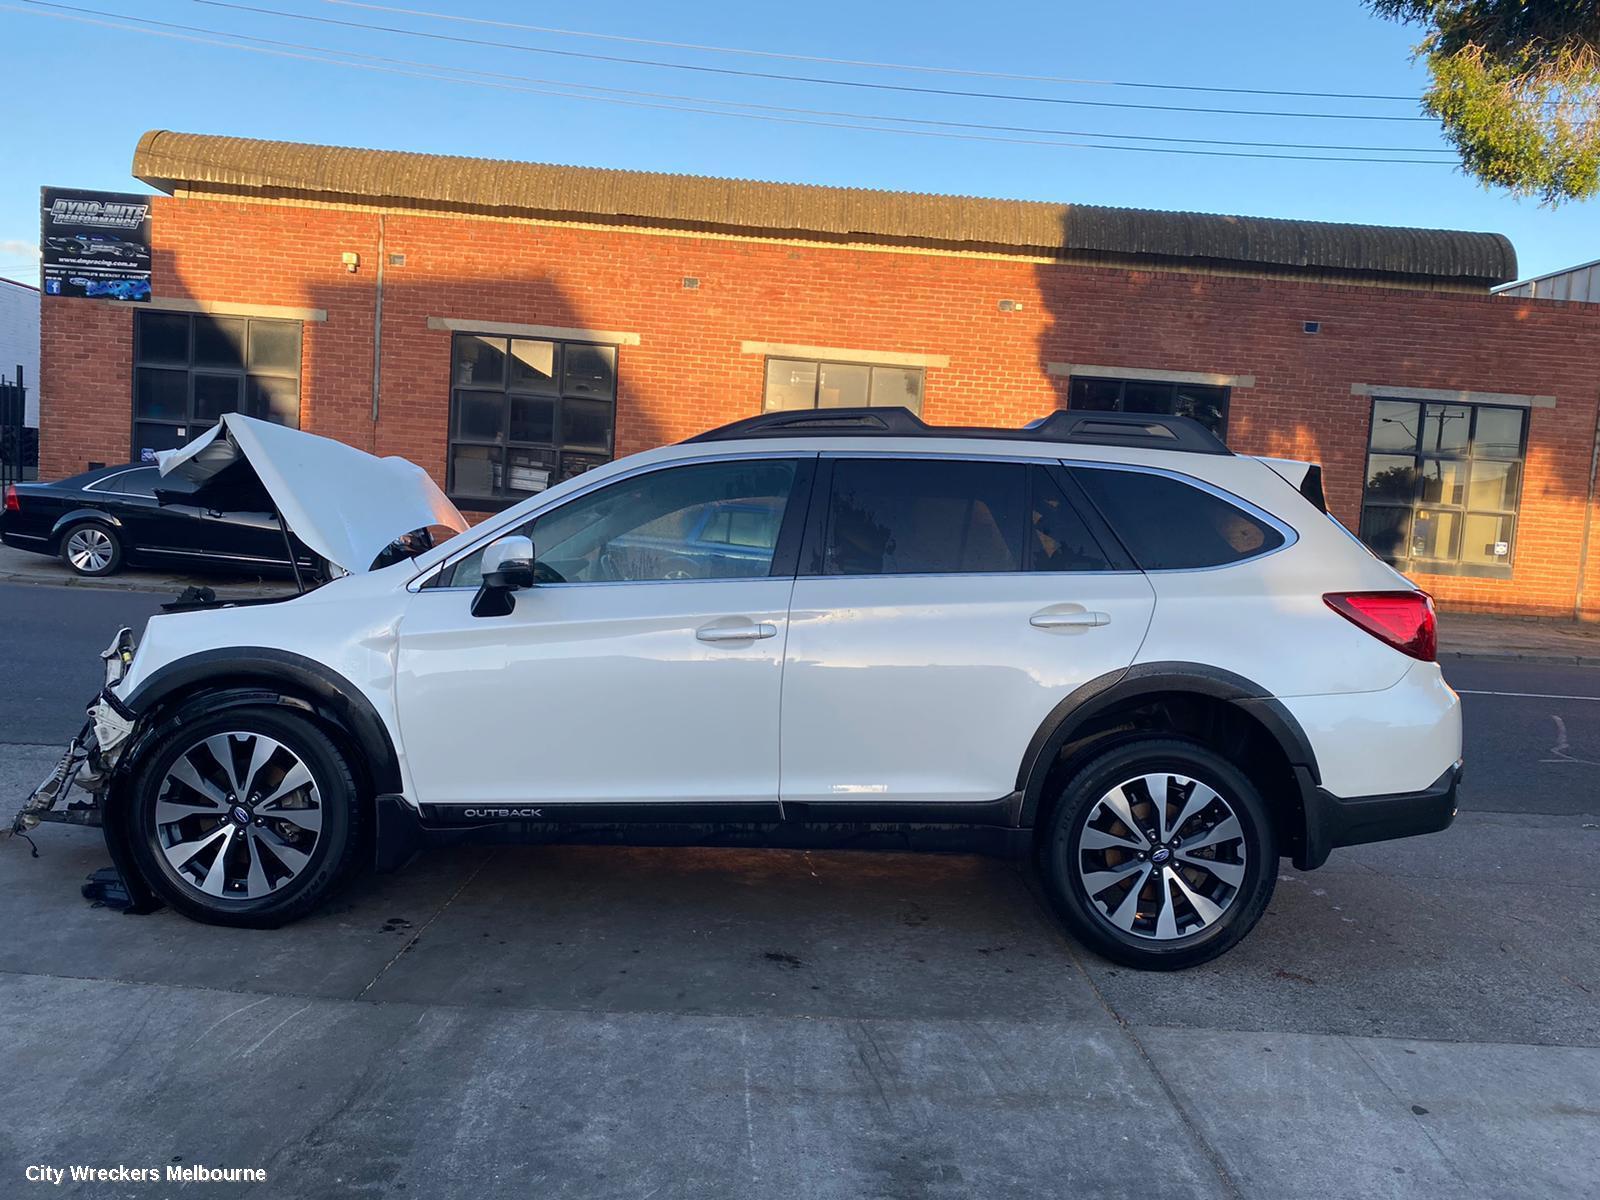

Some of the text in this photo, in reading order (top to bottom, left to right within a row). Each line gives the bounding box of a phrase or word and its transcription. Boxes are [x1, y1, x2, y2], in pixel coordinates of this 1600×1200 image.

[53, 201, 145, 219] DYNO-MITE
[56, 213, 139, 227] PERFORMANCE
[58, 257, 138, 268] www.dmpracing.com.au
[464, 808, 542, 817] OUTBACK
